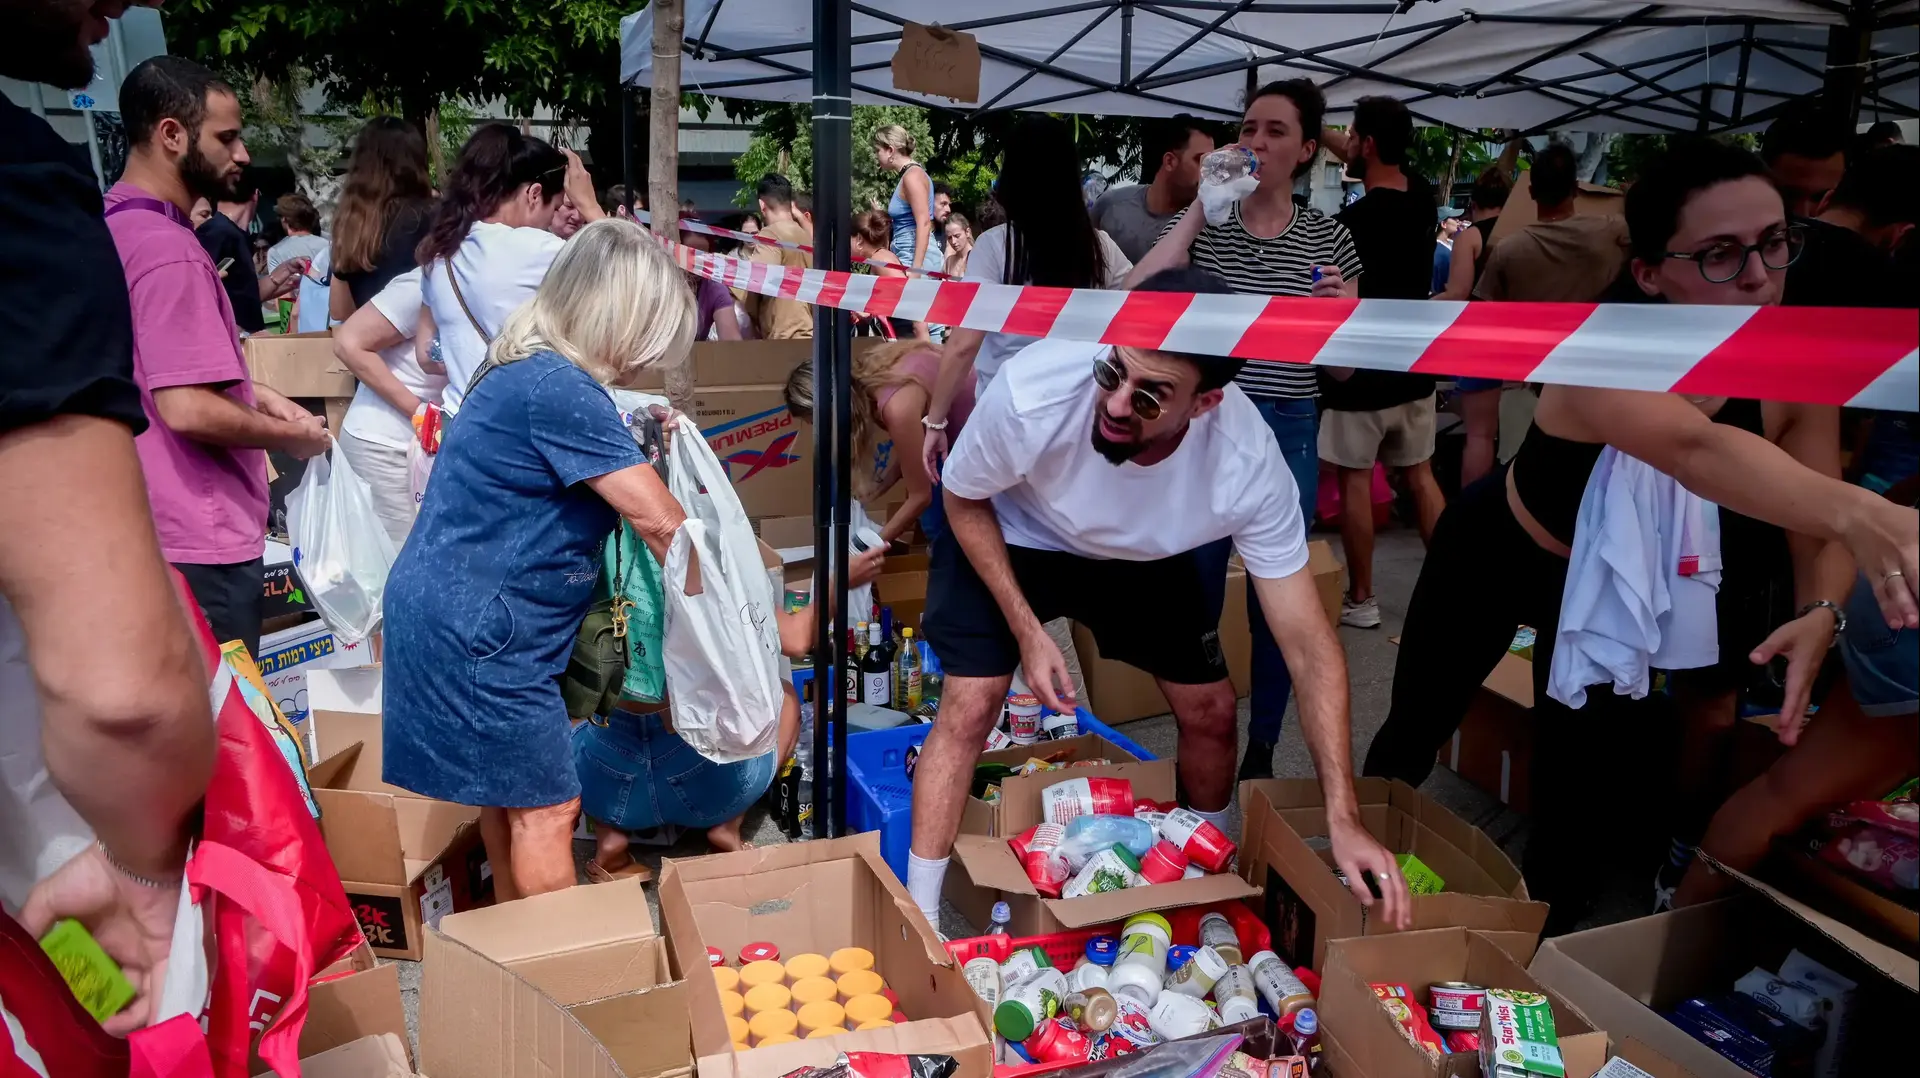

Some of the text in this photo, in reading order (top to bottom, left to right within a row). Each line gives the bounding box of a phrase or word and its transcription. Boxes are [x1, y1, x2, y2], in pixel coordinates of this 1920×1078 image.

[256, 638, 333, 674] ביצי רמות הש
